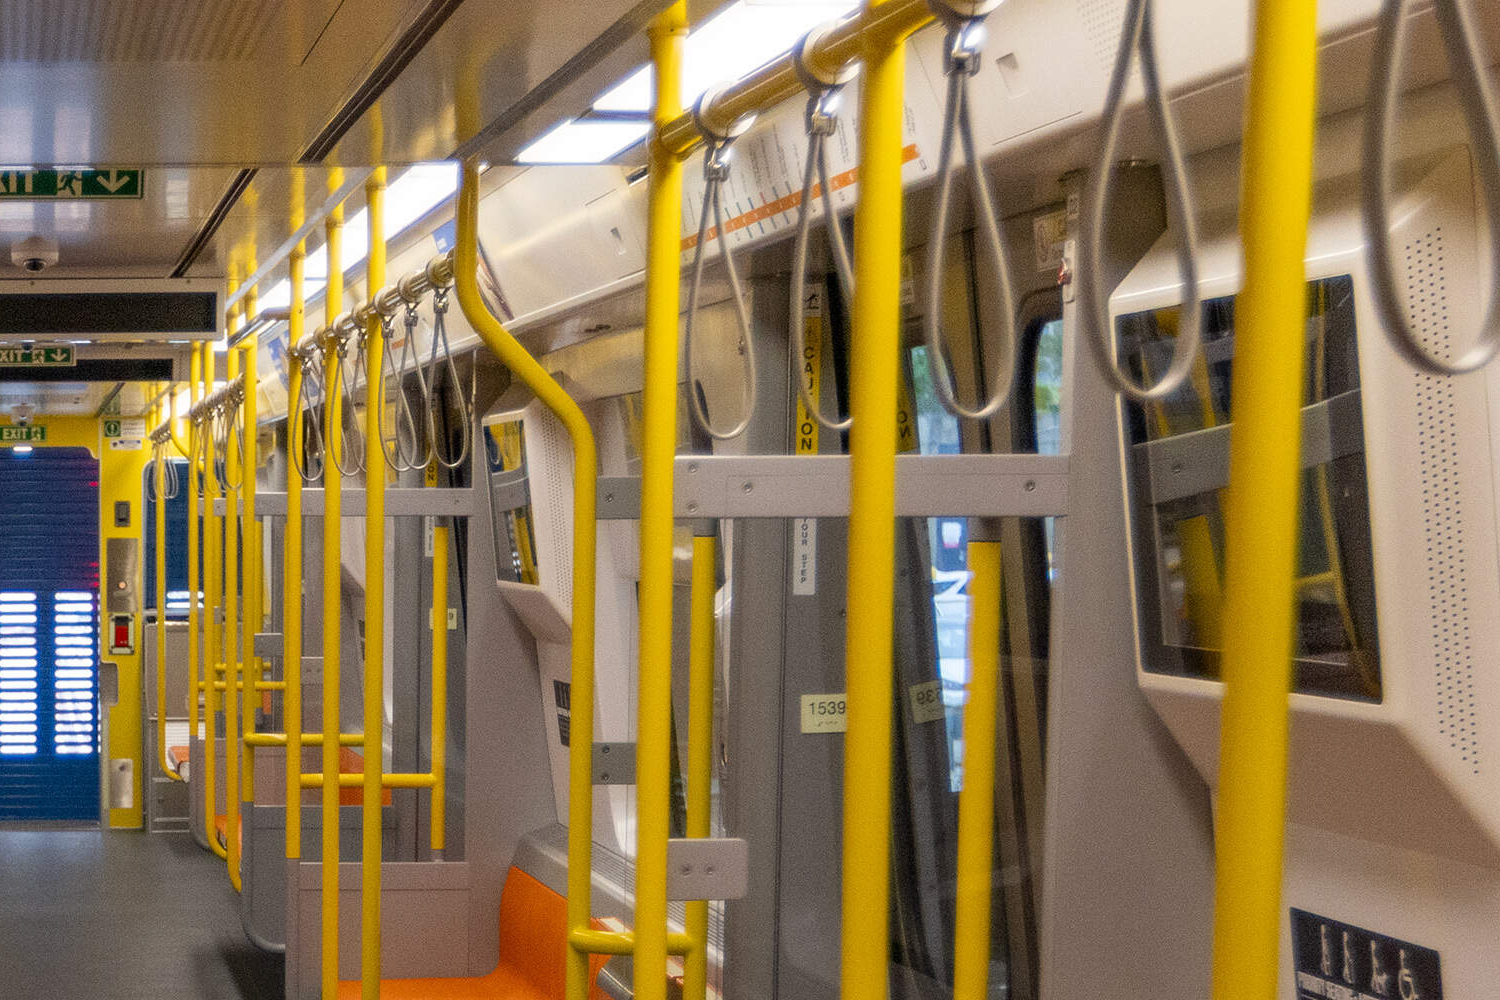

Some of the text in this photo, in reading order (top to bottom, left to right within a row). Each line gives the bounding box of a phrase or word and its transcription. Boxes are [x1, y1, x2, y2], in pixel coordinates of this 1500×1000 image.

[801, 346, 814, 450] CAUION
[3, 428, 28, 440] EXIT
[809, 701, 845, 715] 1539
